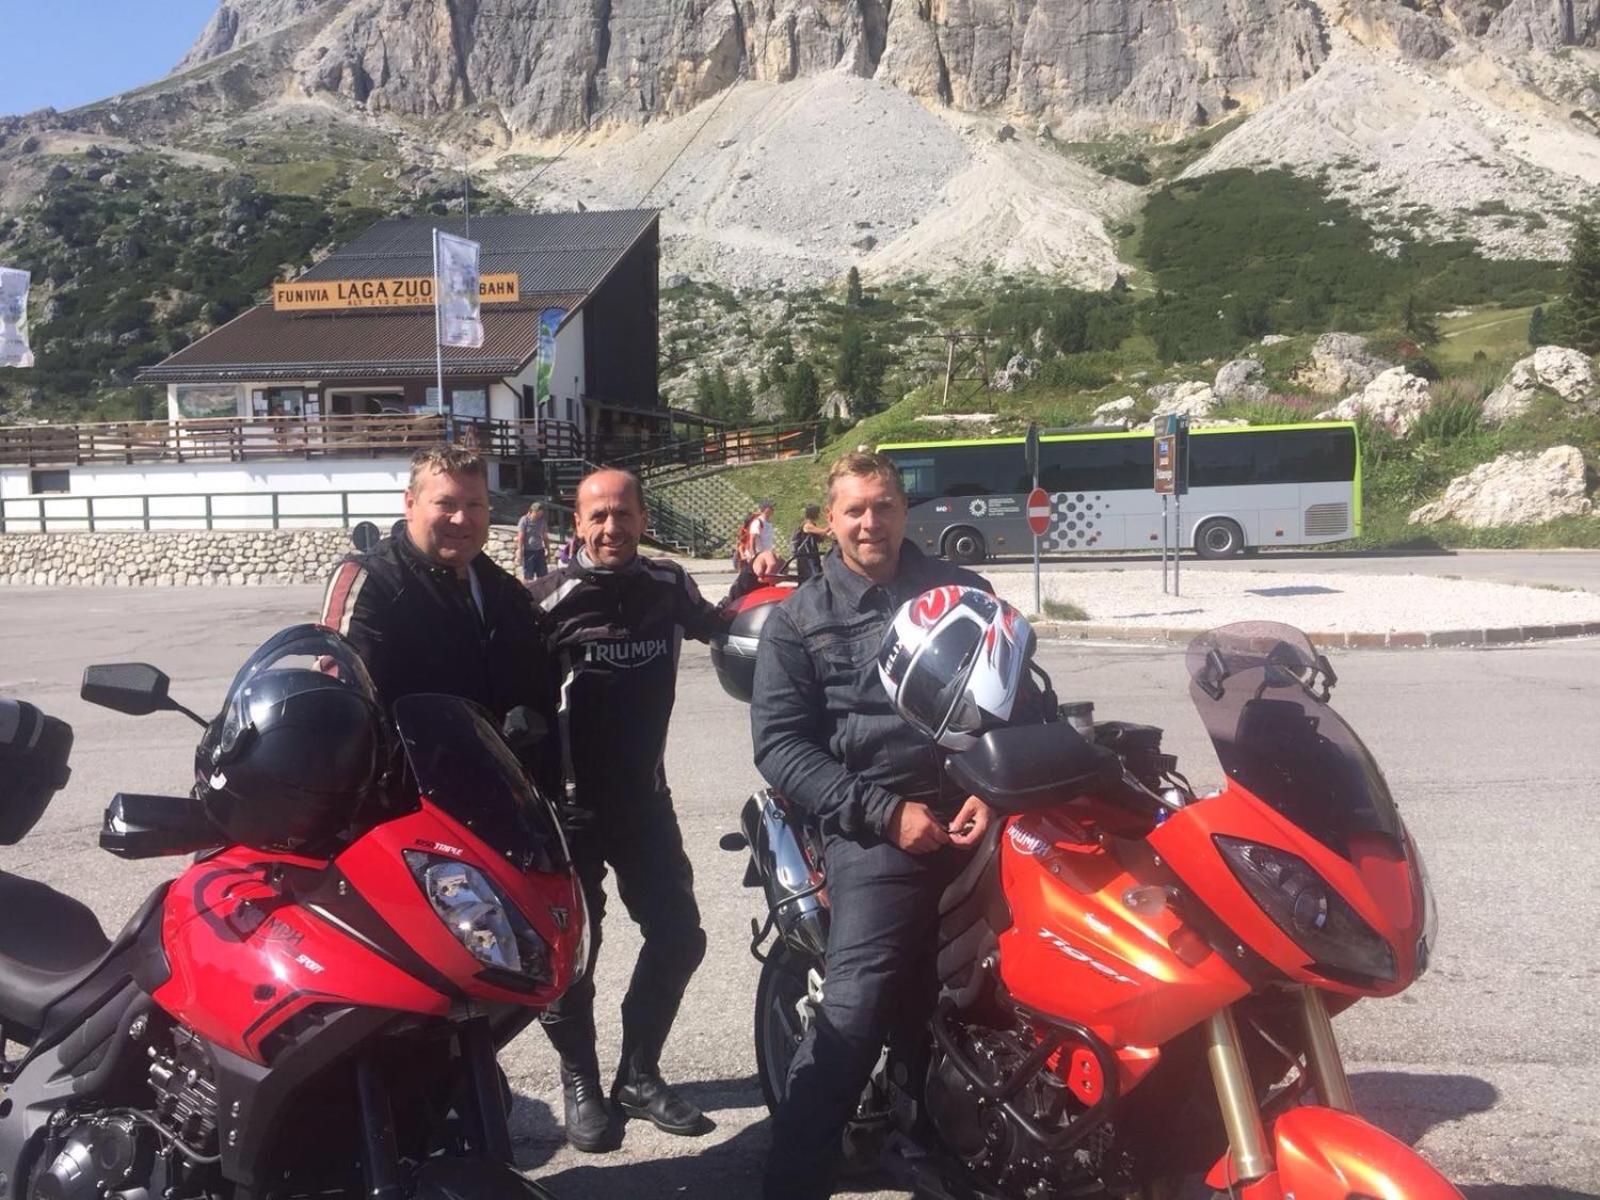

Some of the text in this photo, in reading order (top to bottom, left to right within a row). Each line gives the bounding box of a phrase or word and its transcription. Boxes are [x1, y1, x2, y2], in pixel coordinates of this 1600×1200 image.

[278, 280, 515, 303] FUNIVIA LAGAZUO BAHN
[580, 639, 668, 662] TRIUMPH
[433, 841, 464, 857] TRIPLE
[1007, 823, 1052, 857] TRIUMPH
[295, 953, 325, 974] SPORT
